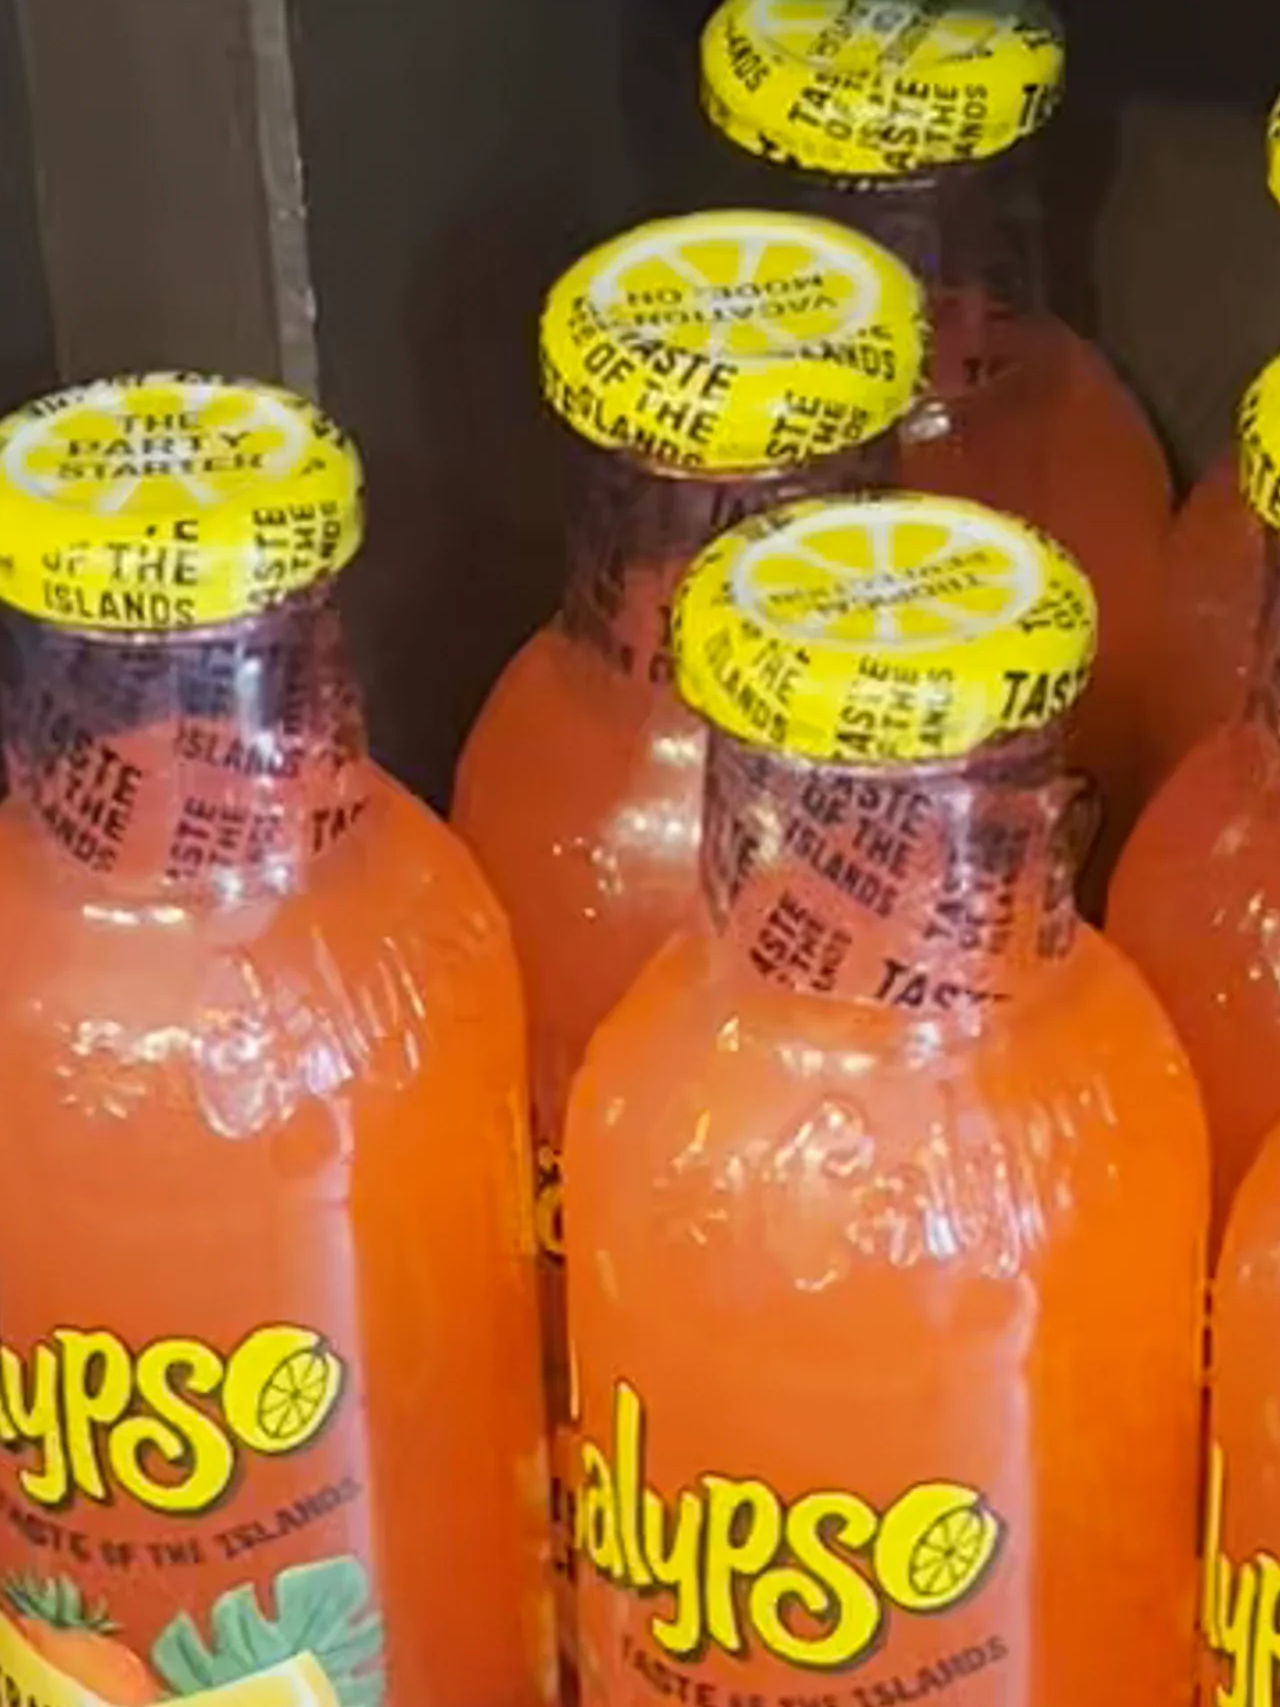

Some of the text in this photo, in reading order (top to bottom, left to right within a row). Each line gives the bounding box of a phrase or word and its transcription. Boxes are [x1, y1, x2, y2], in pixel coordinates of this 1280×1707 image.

[119, 412, 203, 433] THE
[66, 430, 251, 457] PARTY
[56, 453, 266, 480] STARTER
[43, 580, 197, 627] ISLANDS
[576, 1378, 1001, 1666] alypso
